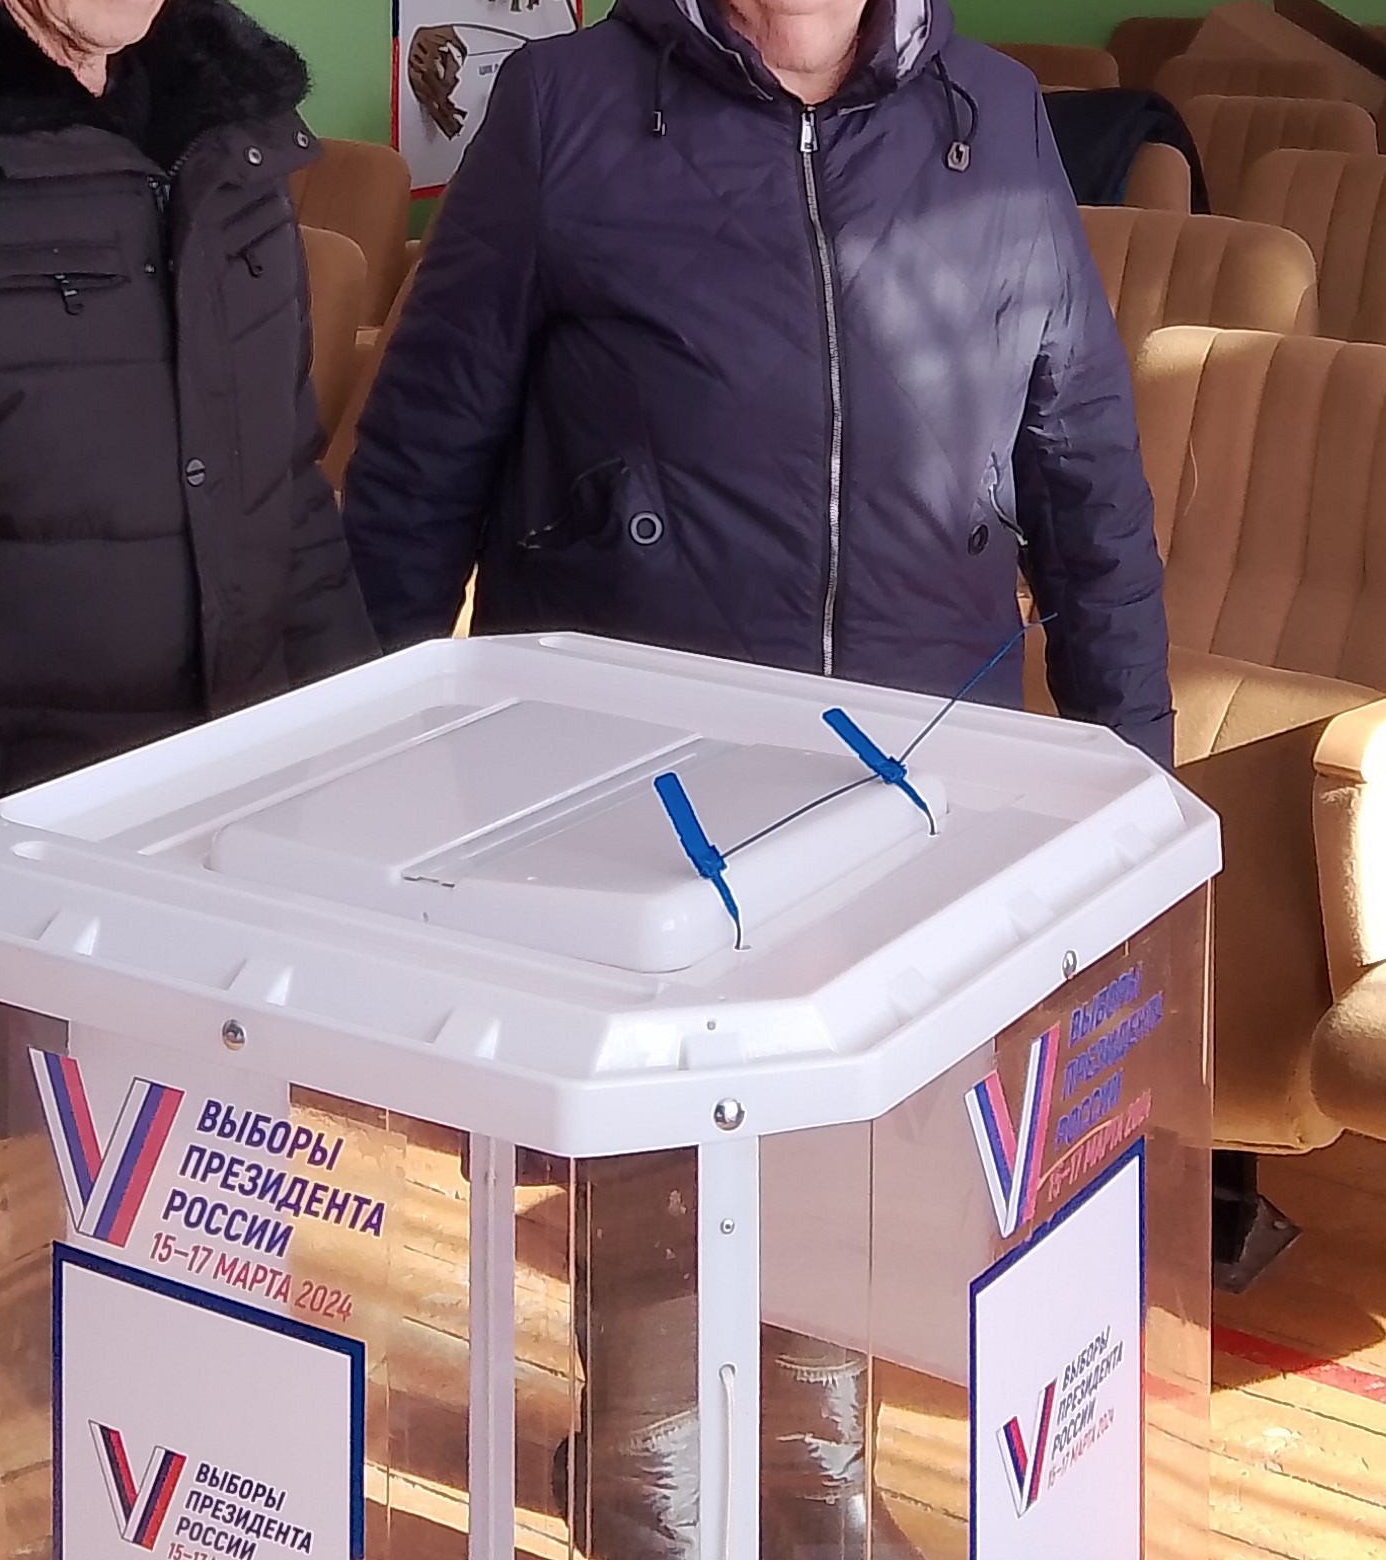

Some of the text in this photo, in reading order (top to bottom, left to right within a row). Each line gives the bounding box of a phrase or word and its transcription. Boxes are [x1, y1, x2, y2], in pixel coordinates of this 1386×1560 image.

[196, 1099, 344, 1171] ВЫБОРЫ
[162, 1189, 294, 1257] РОССИИ
[179, 1144, 386, 1237] ПРЕЗИДЕНТА
[213, 1253, 292, 1303] МАРТА
[294, 1279, 353, 1322] 2024
[1057, 1341, 1123, 1425] ПРЕЗИДЕНТА
[1062, 1325, 1111, 1391] ВЫБОРЫ
[1051, 1397, 1096, 1461] РОССИИ
[195, 1463, 286, 1512] ВЫБОРЫ
[175, 1516, 257, 1560] РОССИИ
[185, 1490, 313, 1554] ПРЕЗИДЕНТА
